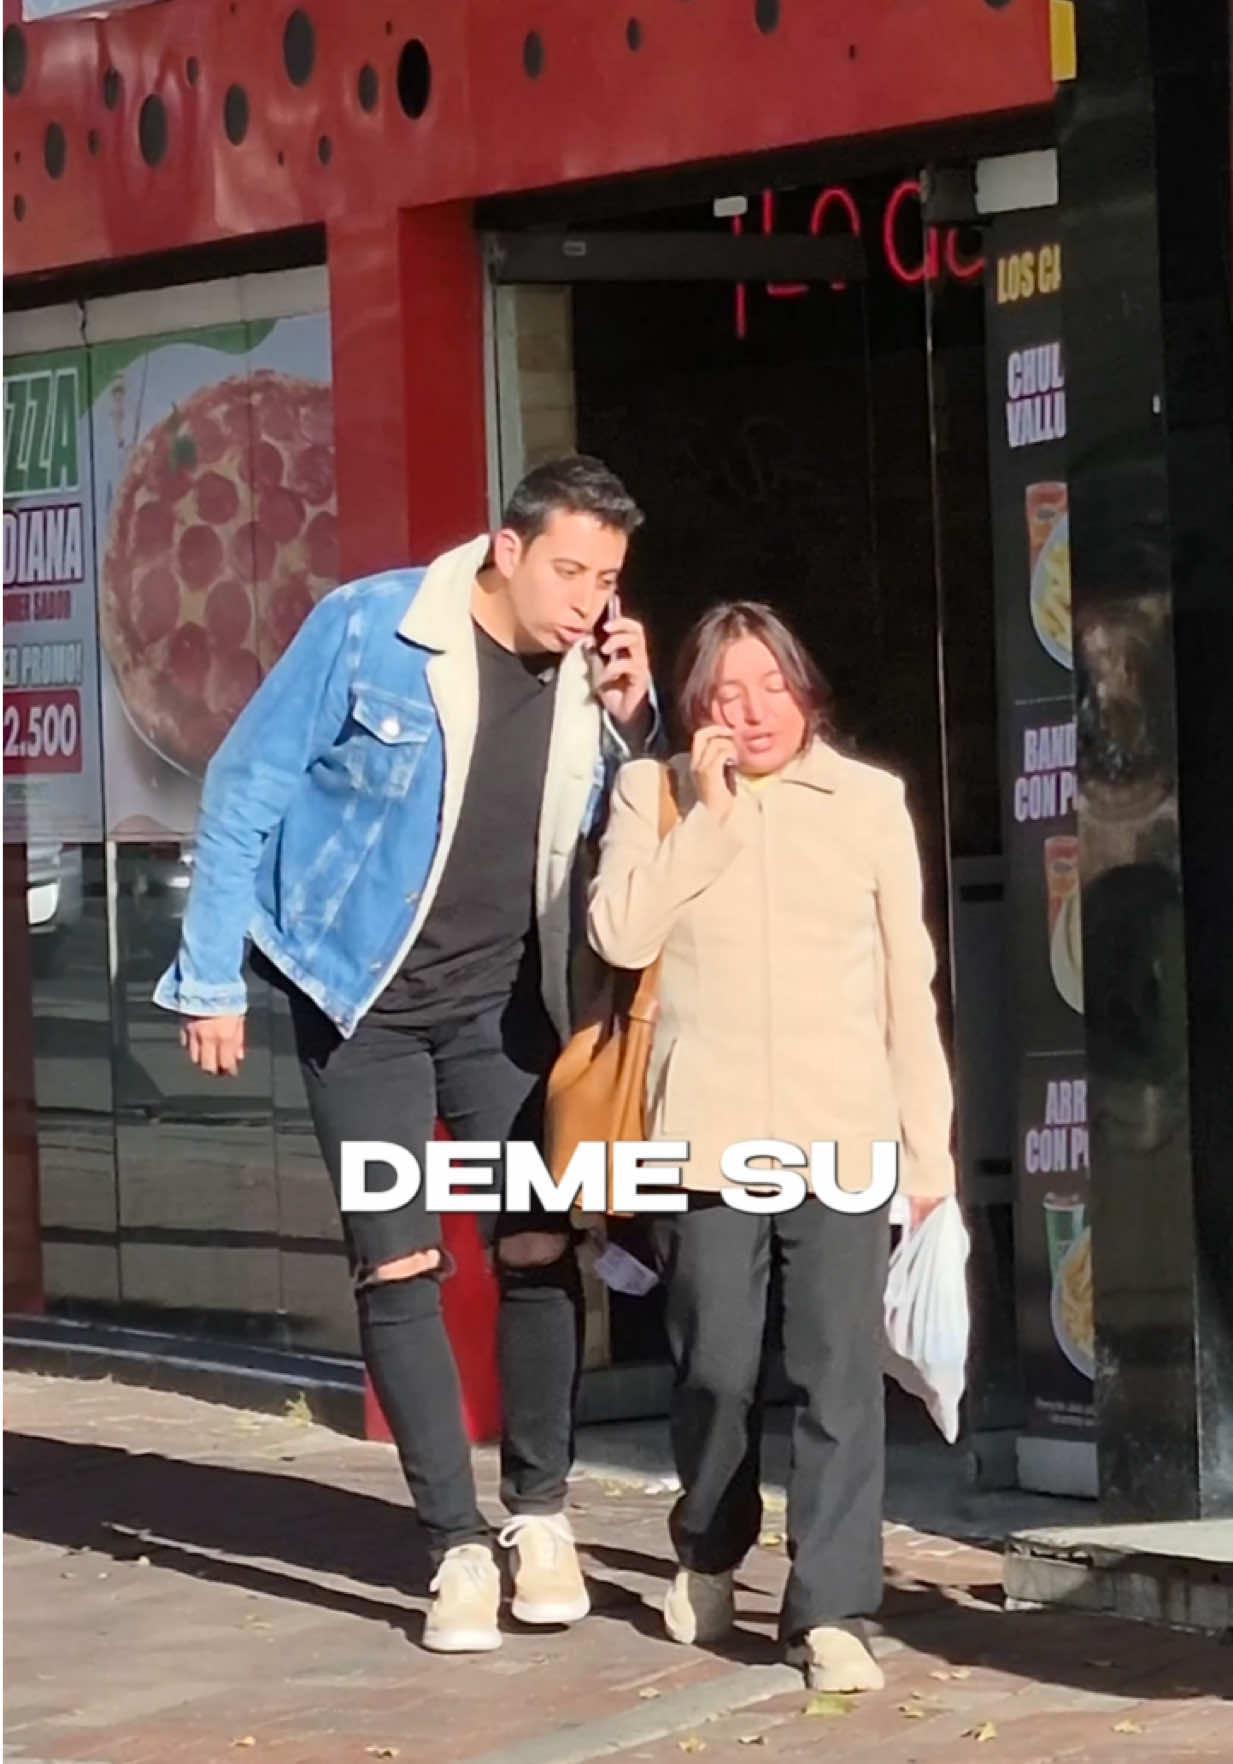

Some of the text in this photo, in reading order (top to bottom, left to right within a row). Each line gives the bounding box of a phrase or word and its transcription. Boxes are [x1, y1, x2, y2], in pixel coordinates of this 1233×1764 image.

[997, 251, 1034, 303] LOS
[1007, 342, 1064, 400] CHUL
[1014, 774, 1056, 822] CON
[1025, 1128, 1067, 1174] CON
